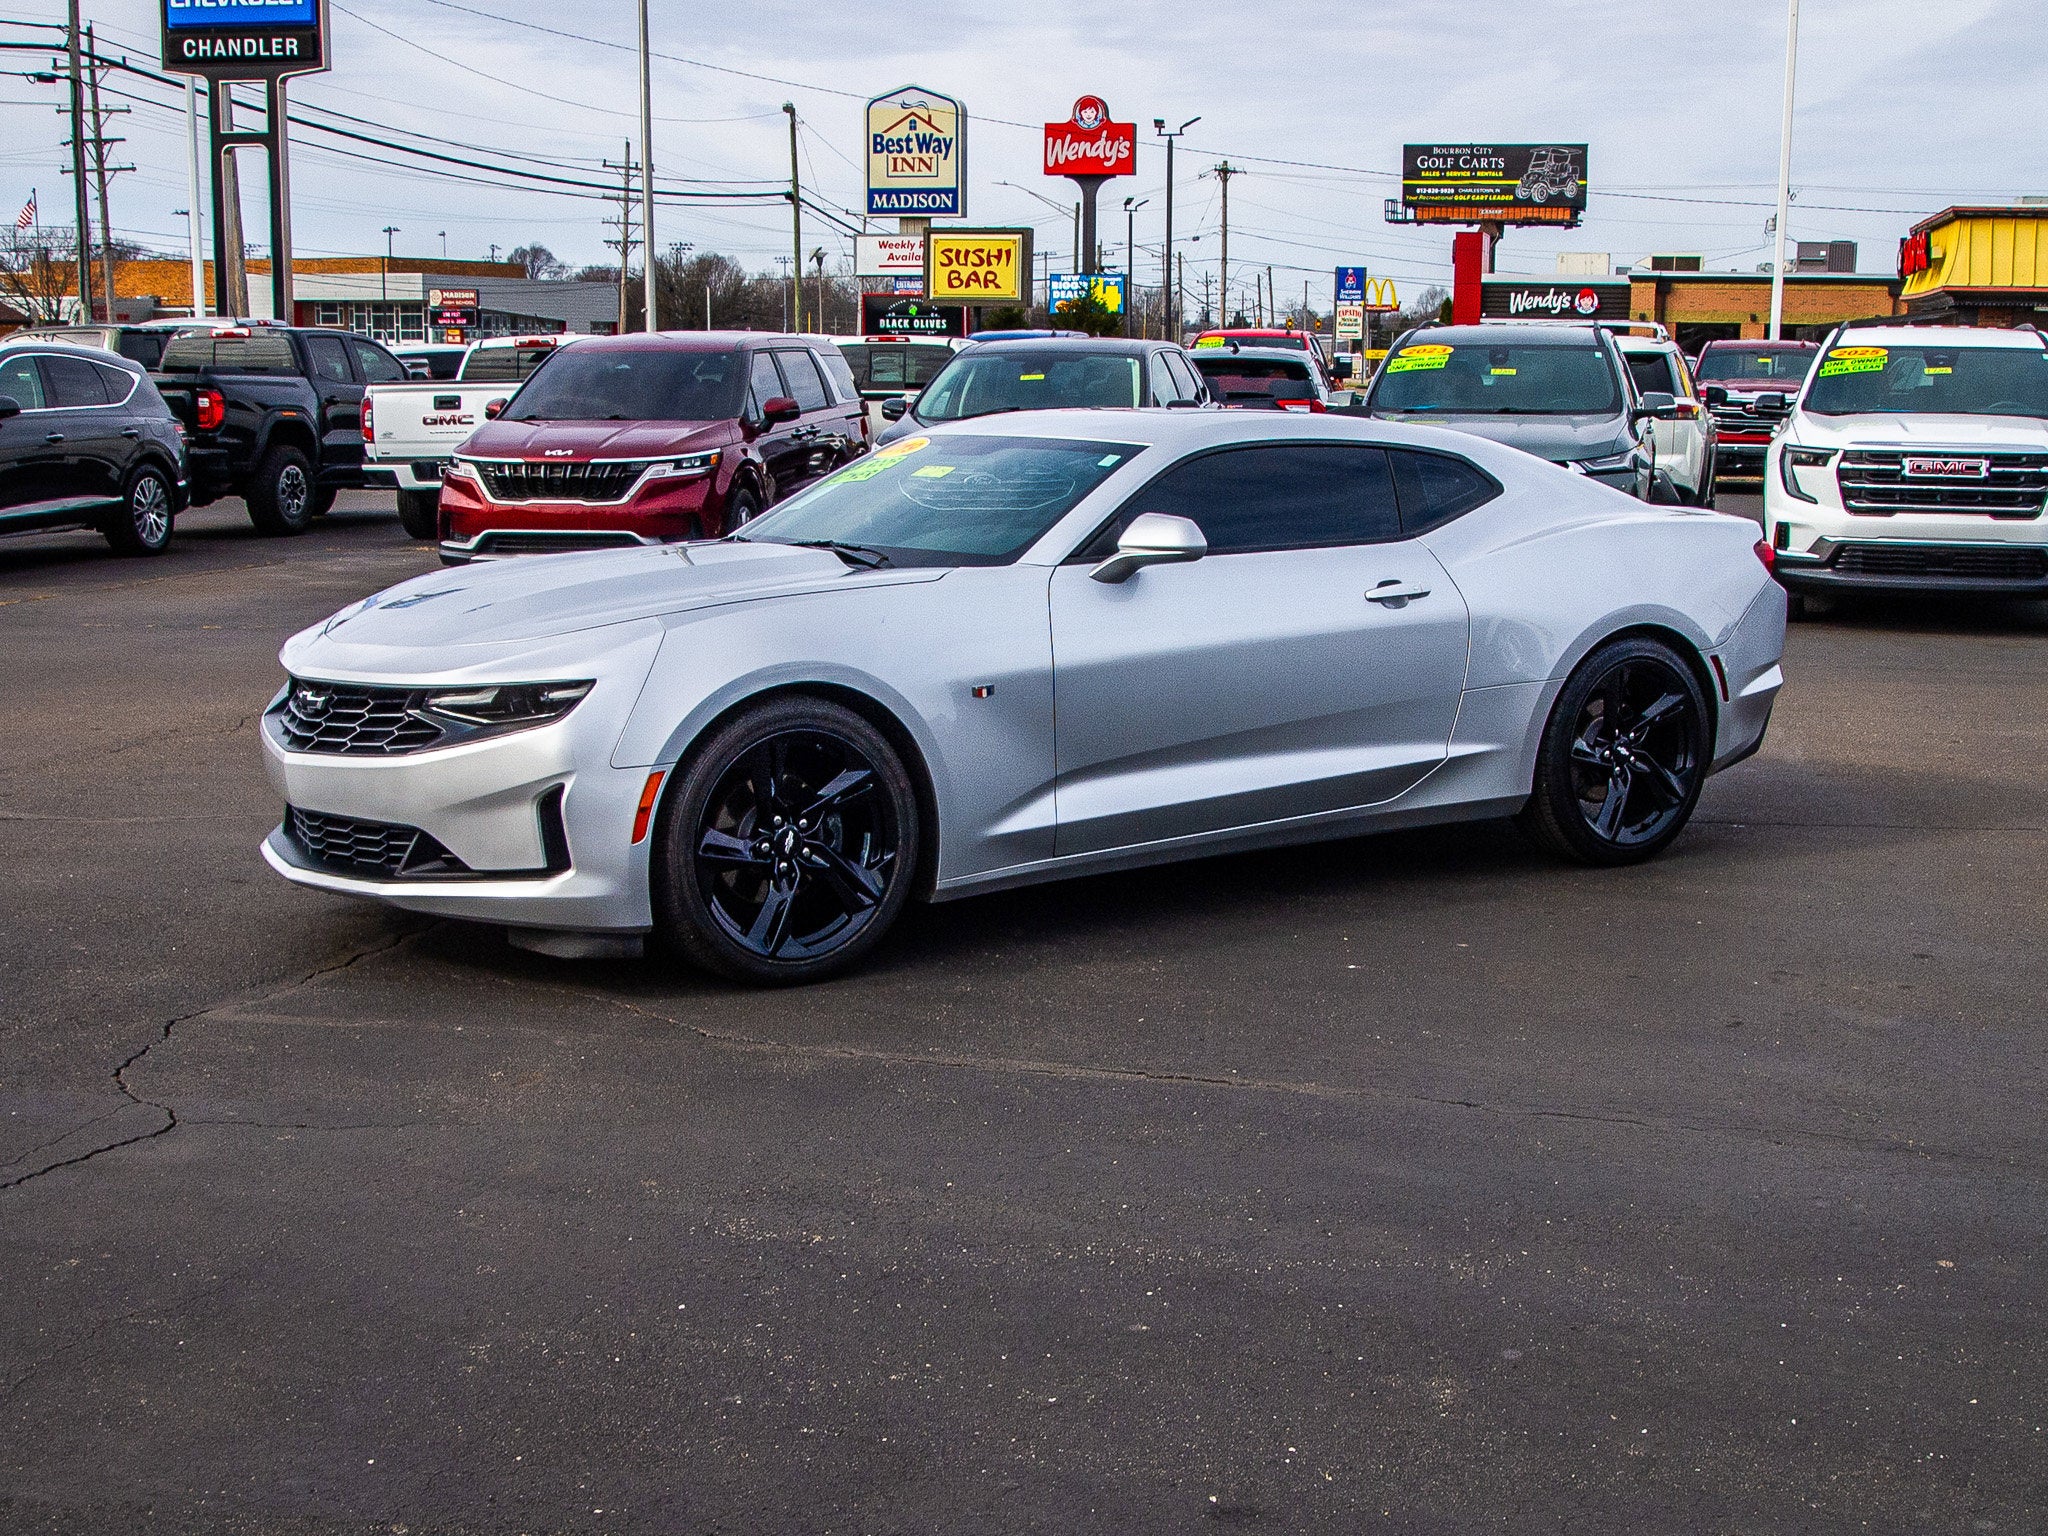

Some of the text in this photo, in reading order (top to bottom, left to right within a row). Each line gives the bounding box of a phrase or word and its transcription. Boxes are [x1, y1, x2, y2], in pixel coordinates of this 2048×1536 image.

[183, 38, 298, 57] CHANDLER
[872, 132, 954, 161] Best Way
[1047, 129, 1131, 168] Wendy's
[1433, 146, 1494, 155] BOURBON CITY
[891, 157, 934, 172] INN
[1416, 155, 1505, 169] GOLF CARTS
[872, 193, 953, 208] MADISON
[878, 240, 915, 251] Weekly
[940, 248, 1012, 267] SUSHI
[947, 269, 1002, 289] BAR
[442, 291, 475, 299] MADISON
[1509, 287, 1572, 314] Wendy's
[879, 319, 947, 329] BLACK OLIVES
[1836, 349, 1881, 357] 2025
[1410, 361, 1444, 369] OWNER
[1850, 357, 1886, 365] OWNER
[1821, 364, 1881, 375] EXTRA CLEAN
[422, 414, 475, 426] GMC
[1911, 460, 1982, 475] GMC
